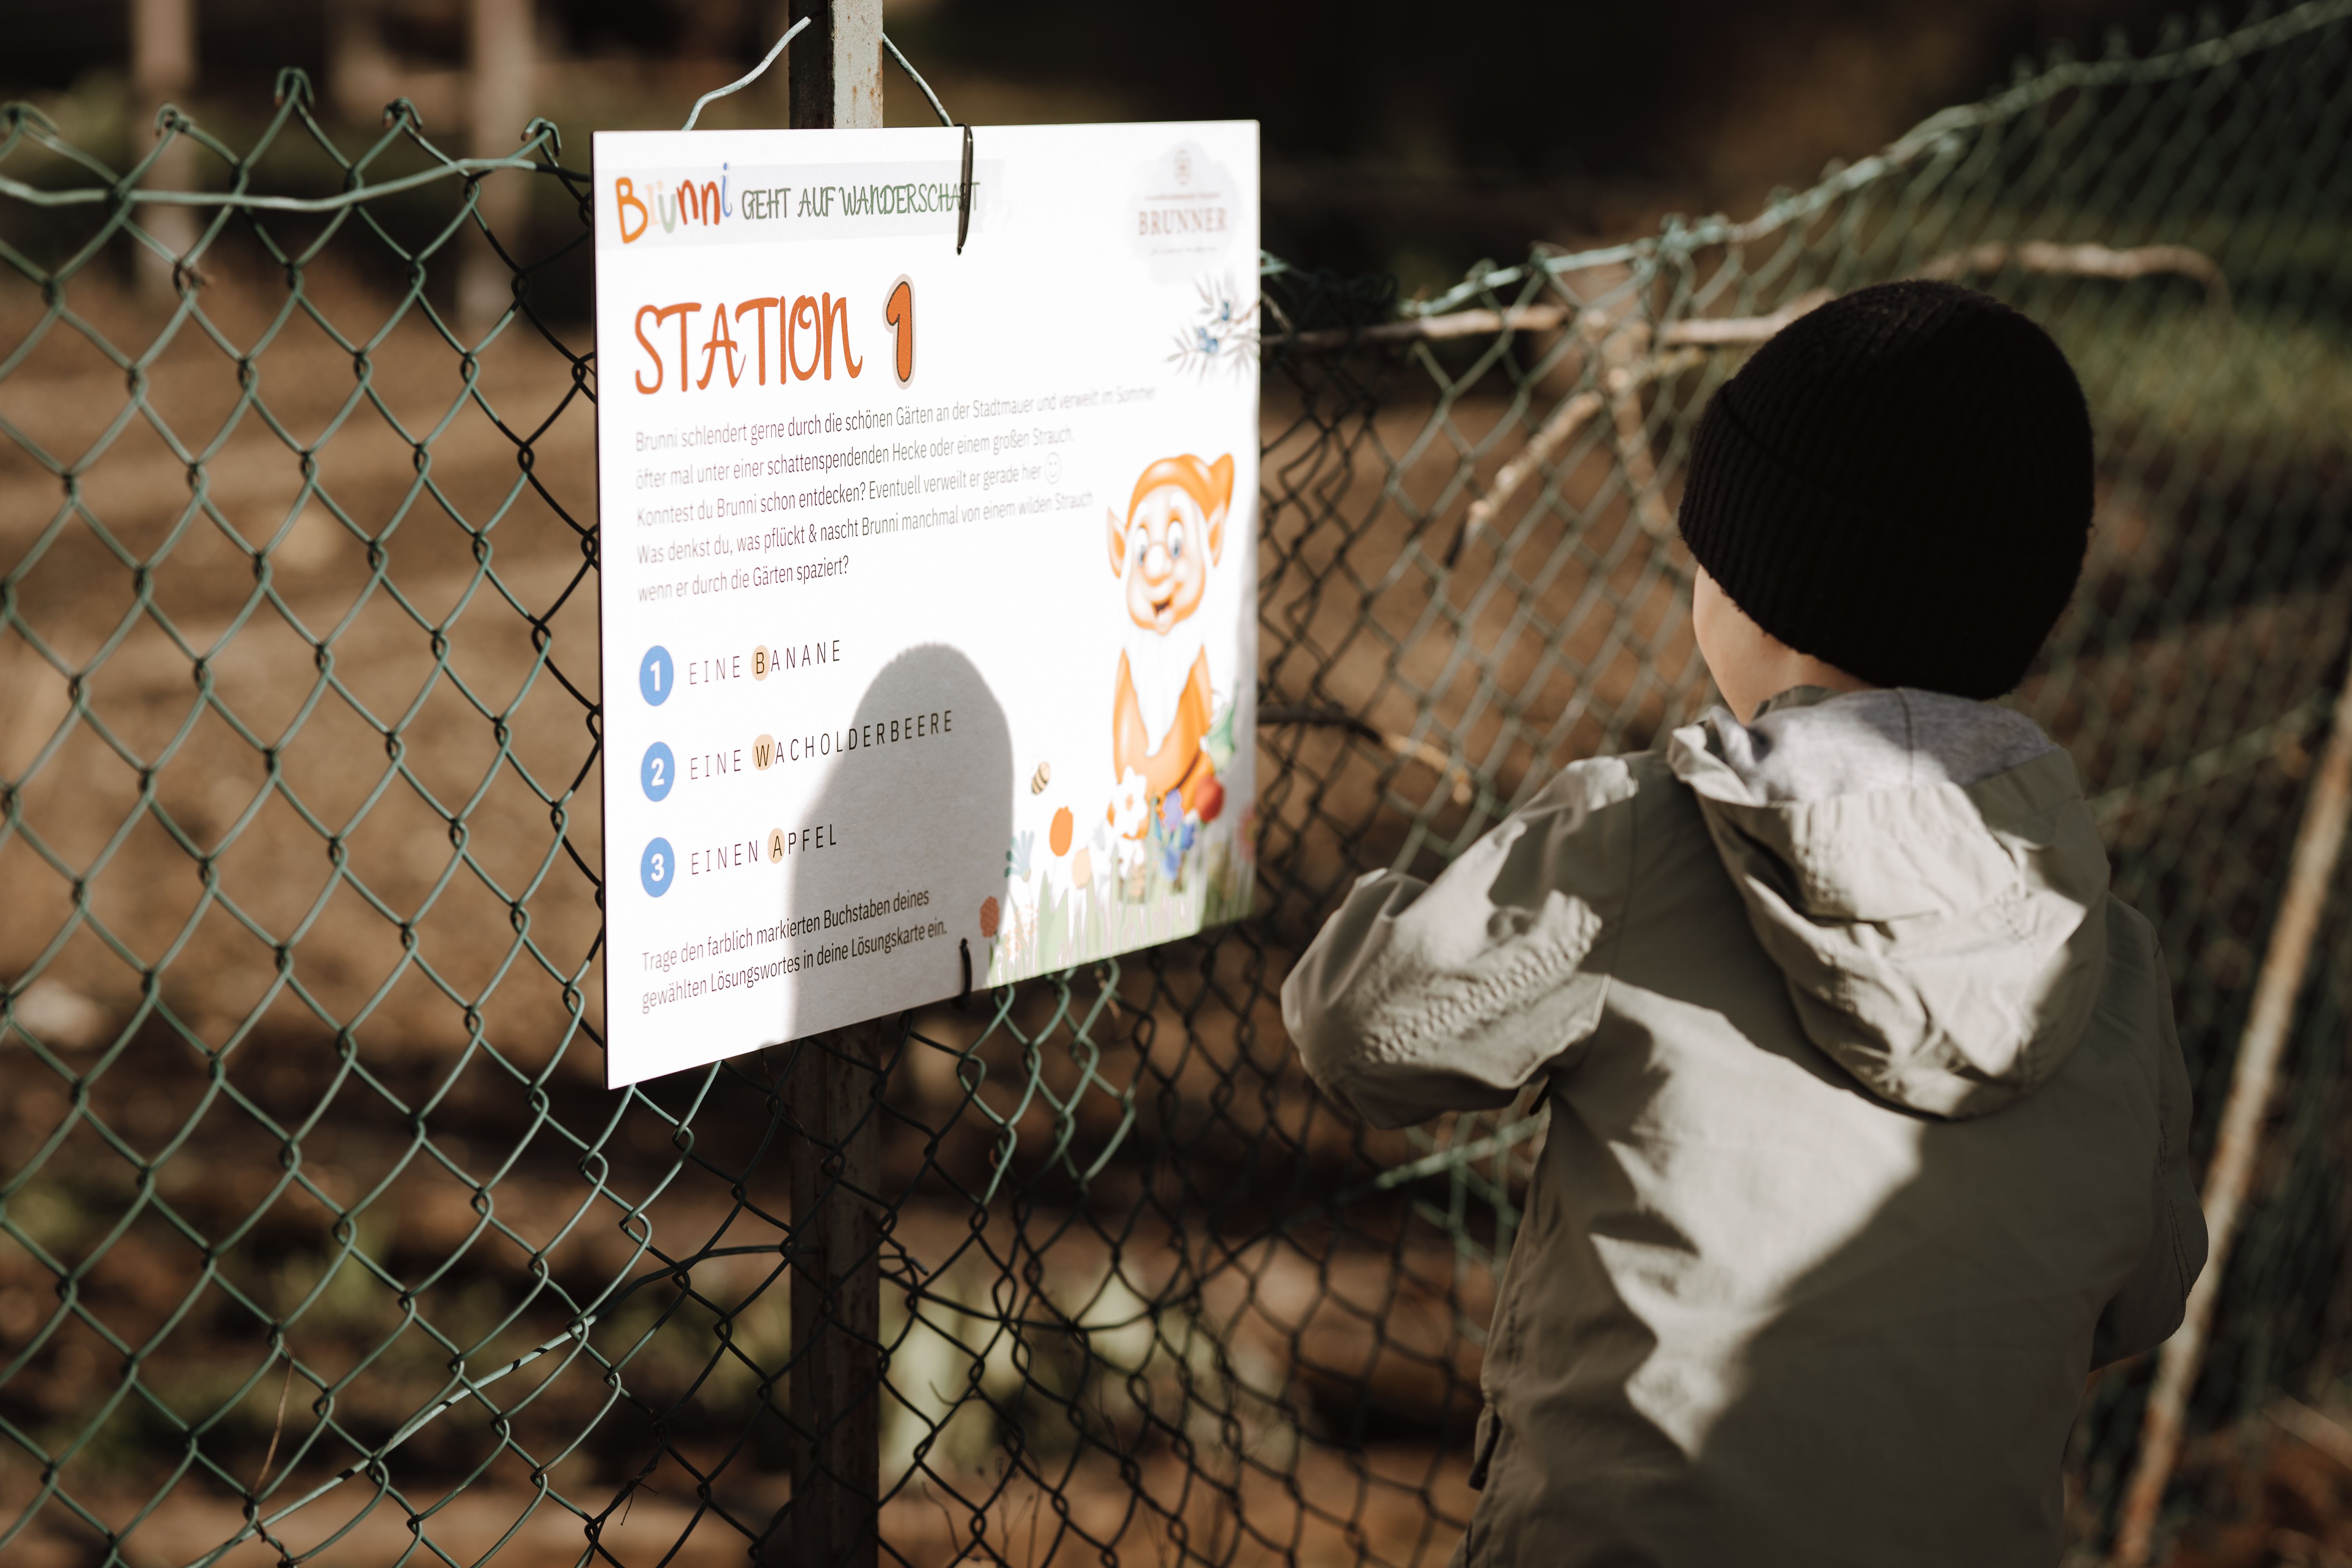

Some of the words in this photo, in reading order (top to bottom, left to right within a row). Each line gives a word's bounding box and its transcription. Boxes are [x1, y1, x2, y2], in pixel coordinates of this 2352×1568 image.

[615, 162, 732, 243] Brunni
[742, 188, 791, 220] GEHT
[797, 186, 835, 217] AUF
[1139, 207, 1227, 235] BRUNNER
[885, 280, 913, 383] 1
[636, 428, 677, 452] Brunni
[682, 423, 747, 447] schlendert
[751, 423, 784, 445] gerne
[788, 414, 821, 437] durch
[825, 413, 842, 432] die
[846, 410, 892, 430] schönen
[897, 406, 933, 425] Gärten
[936, 407, 949, 421] an
[953, 401, 970, 420] der
[973, 397, 1034, 418] Stadtmauer
[1037, 392, 1056, 412] und
[1060, 387, 1099, 408] verweilt
[636, 467, 665, 490] öfter
[671, 464, 693, 485] mal
[698, 463, 730, 483] unter
[734, 458, 764, 479] einer
[768, 445, 889, 475] schattenspendenden
[893, 440, 926, 461] Hecke
[930, 437, 954, 456] oder
[957, 435, 989, 454] einem
[993, 429, 1029, 455] großen
[637, 504, 693, 526] Konntest
[698, 500, 713, 519] du
[718, 494, 756, 517] Brunni
[760, 491, 795, 512] schon
[799, 482, 866, 508] entdecken?
[869, 474, 921, 499] Eventuell
[924, 470, 967, 493] verweilt
[970, 473, 980, 487] er
[983, 465, 1019, 491] gerade
[1022, 463, 1041, 481] hier
[637, 545, 664, 564] Was
[668, 539, 710, 561] denkst
[714, 535, 733, 557] du,
[737, 535, 760, 552] was
[765, 524, 804, 553] pflückt
[809, 524, 817, 543] &
[821, 518, 858, 541] nascht
[862, 512, 898, 536] Brunni
[902, 505, 958, 530] manchmal
[962, 507, 980, 523] von
[983, 501, 1015, 520] einem
[1019, 495, 1052, 515] wilden
[1055, 489, 1093, 510] Strauch
[638, 582, 672, 602] wenn
[676, 582, 688, 597] er
[692, 572, 727, 595] durch
[731, 568, 749, 589] die
[753, 566, 793, 586] Gärten
[797, 555, 849, 584] spaziert?
[650, 660, 661, 691] 1
[690, 655, 740, 685] EINE
[756, 640, 840, 675] BANANE
[651, 758, 665, 786] 2
[690, 750, 741, 780] EINE
[756, 710, 952, 767] WACHOLDERBEERE
[651, 854, 664, 882] 3
[691, 840, 758, 875] EINEN
[773, 824, 837, 858] APFEL
[642, 950, 677, 972] Trage
[681, 942, 703, 962] den
[708, 927, 752, 956] farblich
[757, 916, 820, 945] markierten
[824, 898, 890, 929] Buchstaben
[893, 890, 929, 912] deines
[642, 979, 706, 1014] gewählten
[711, 956, 800, 992] Lösungswortes
[804, 949, 813, 969] in
[817, 943, 848, 965] deine
[852, 924, 925, 957] Lösungskarte
[928, 917, 947, 938] ein.
